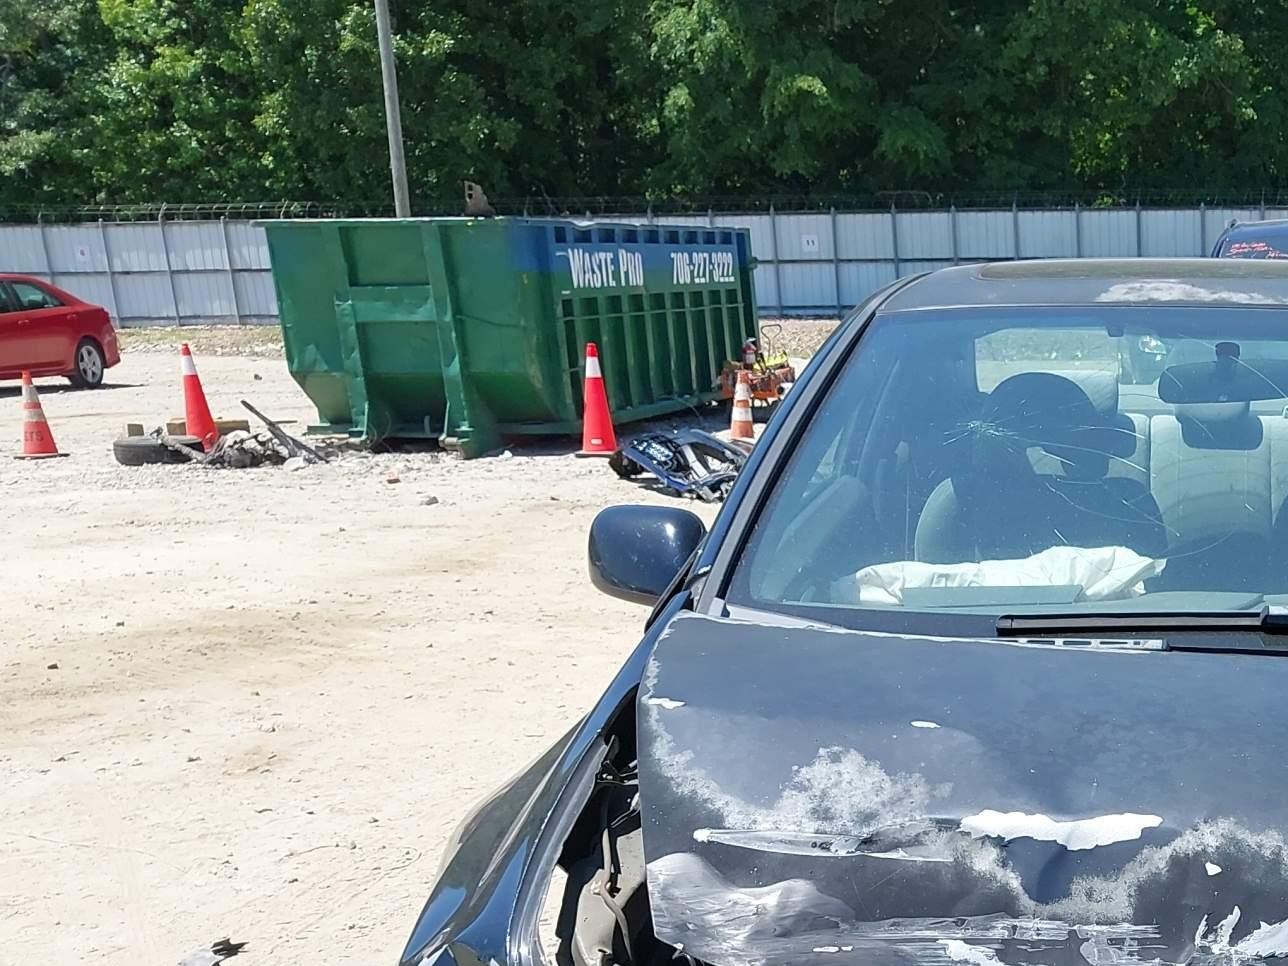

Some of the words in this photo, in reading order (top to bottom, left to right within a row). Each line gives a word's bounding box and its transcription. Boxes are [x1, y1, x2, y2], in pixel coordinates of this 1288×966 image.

[568, 248, 616, 289] WASTE
[618, 249, 644, 287] PRO
[670, 251, 735, 285] 706-227-3222
